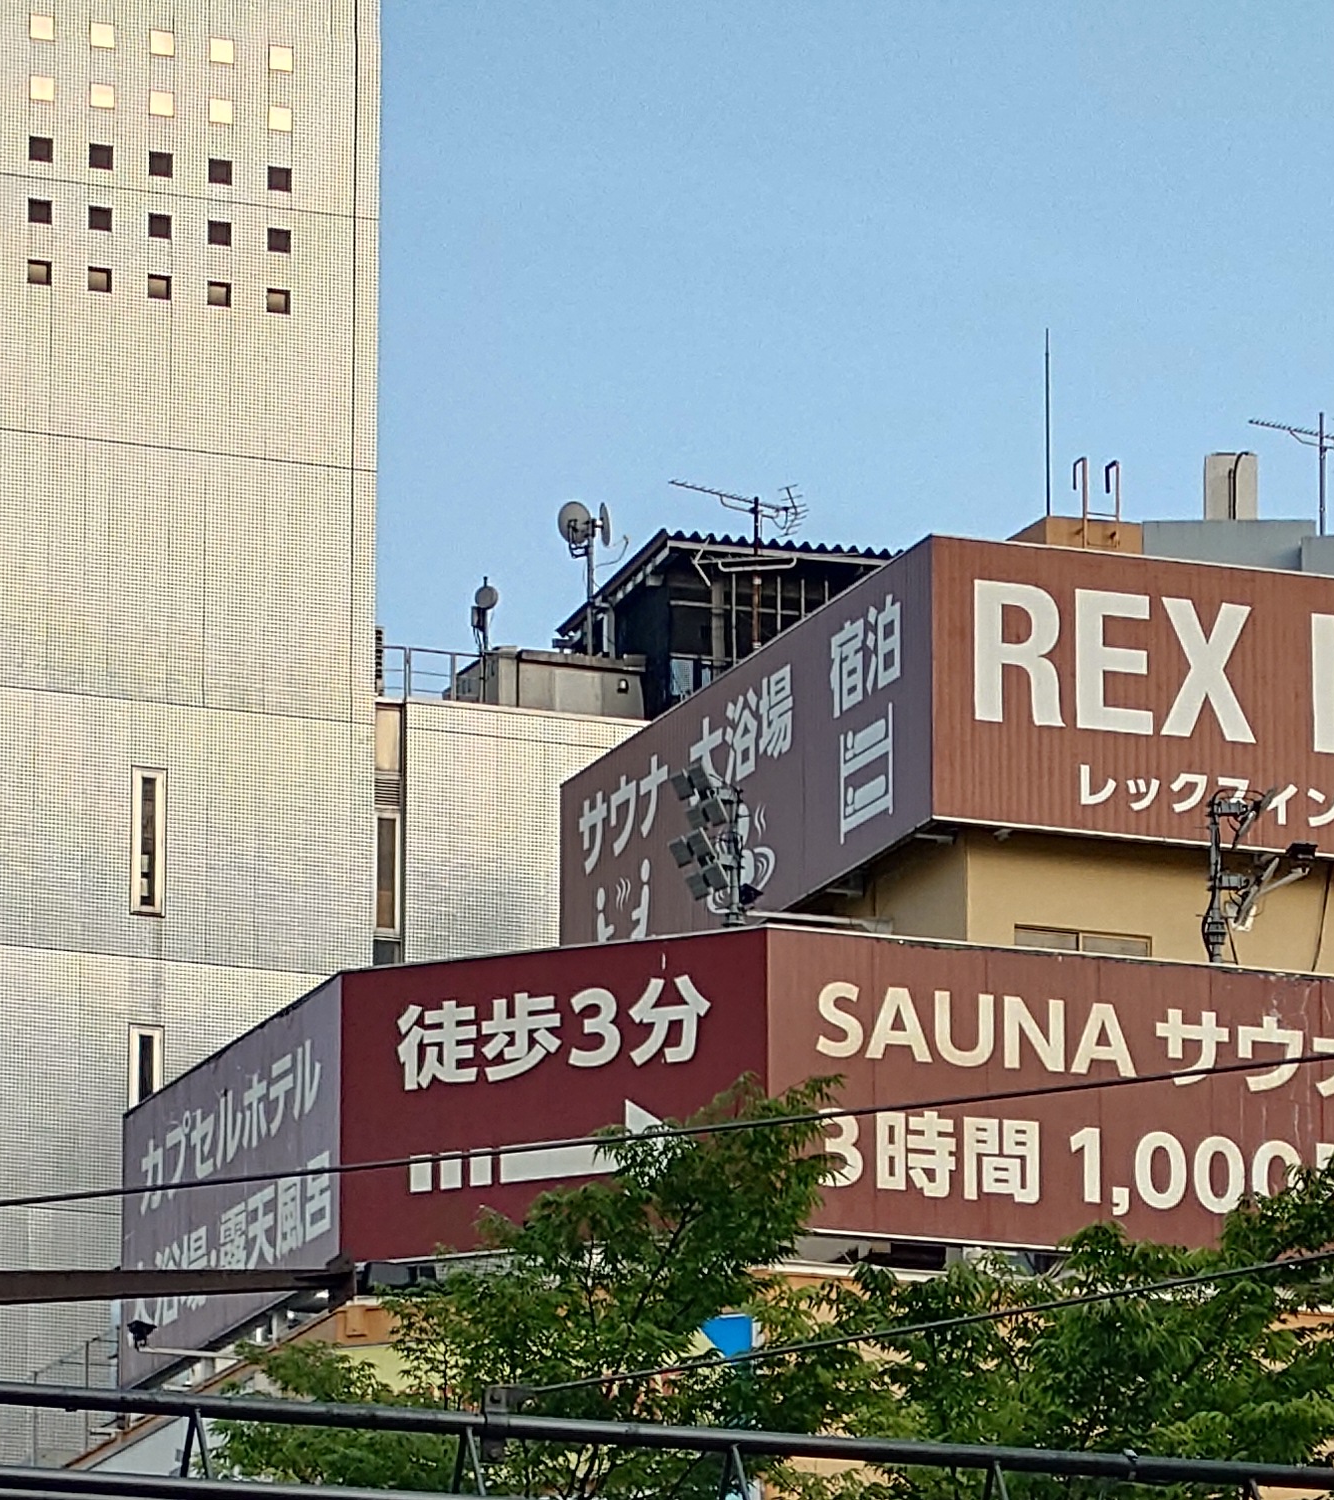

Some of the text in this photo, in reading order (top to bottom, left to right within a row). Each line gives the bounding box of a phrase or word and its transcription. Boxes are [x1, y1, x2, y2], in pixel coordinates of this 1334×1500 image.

[829, 593, 902, 719] 宿泊
[973, 578, 1256, 744] REX
[689, 663, 794, 785] 大浴場
[578, 754, 669, 876] サウナ
[396, 973, 711, 1092] 徒歩3分
[816, 980, 1137, 1079] SAUNA
[140, 1038, 322, 1217] カプセルホテル
[817, 1108, 1042, 1205] 3時間
